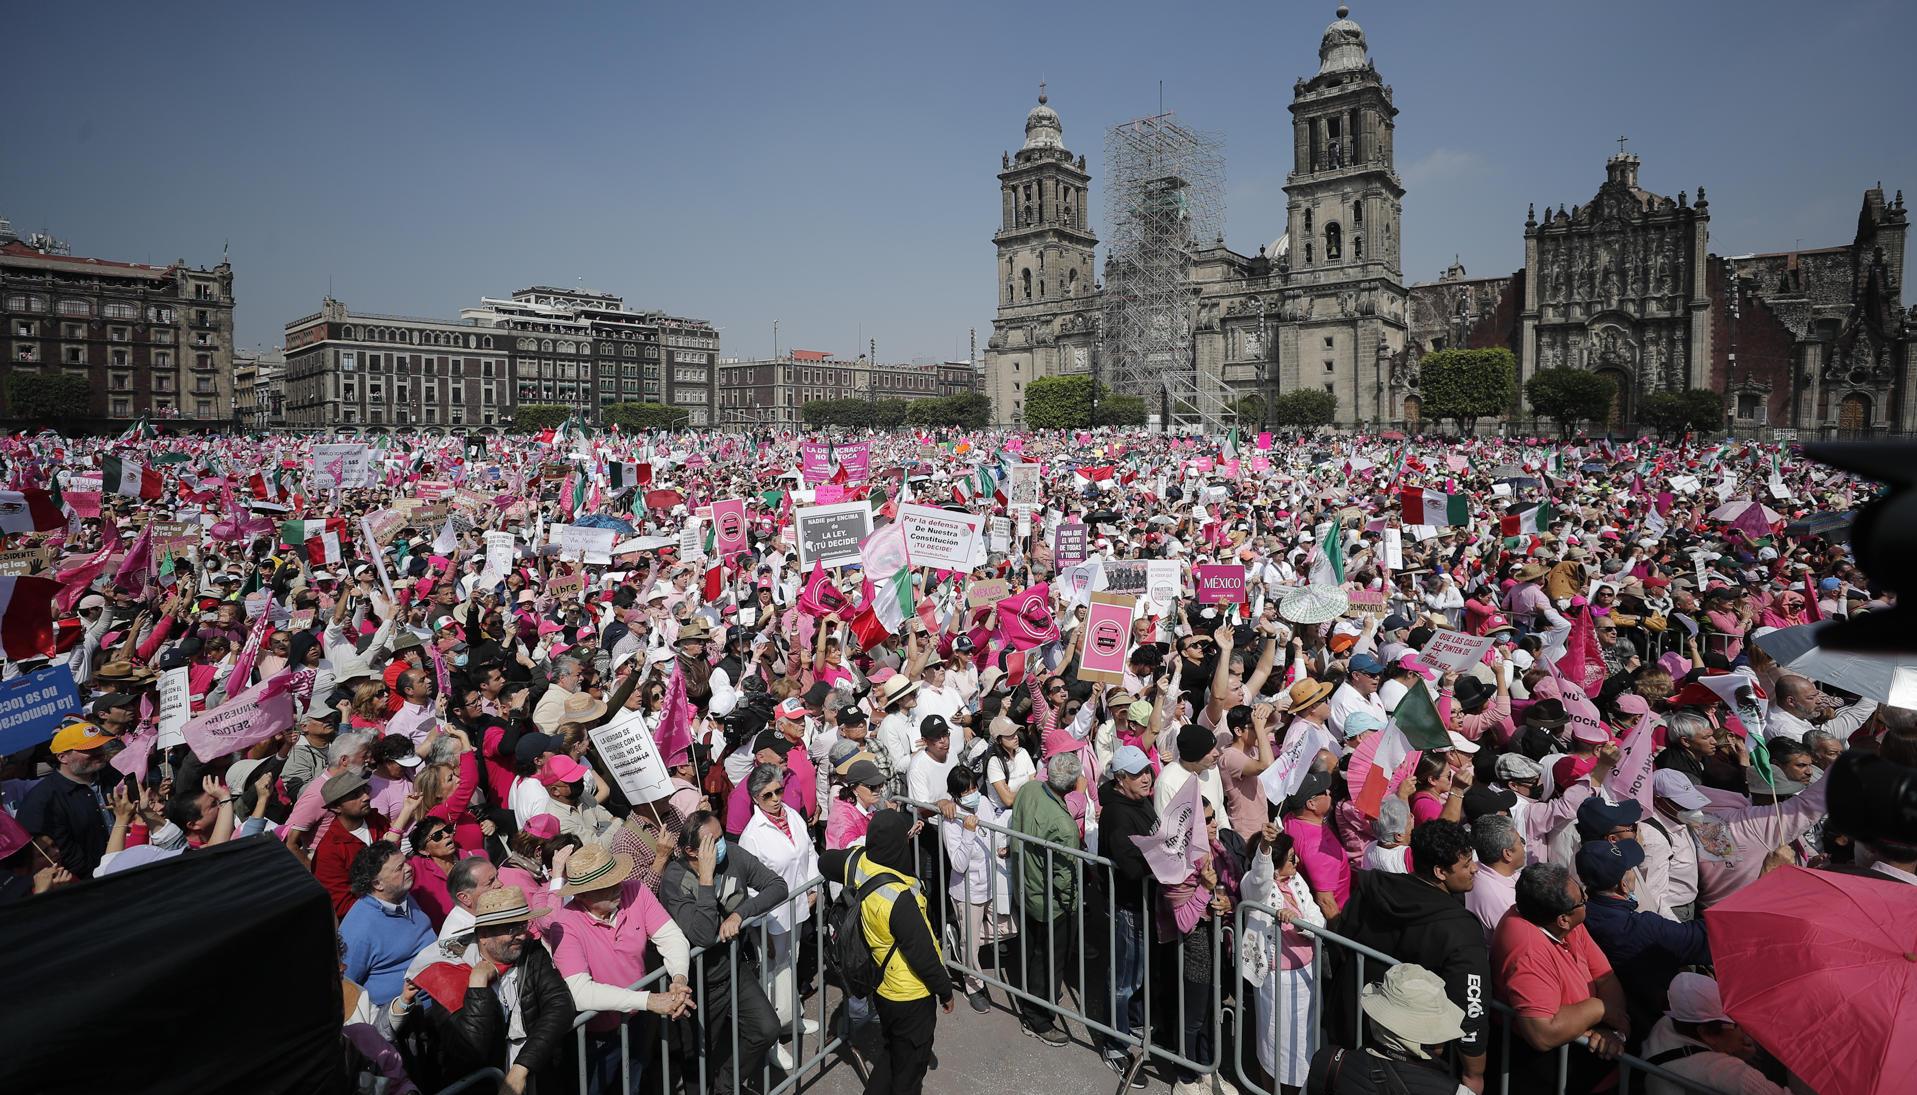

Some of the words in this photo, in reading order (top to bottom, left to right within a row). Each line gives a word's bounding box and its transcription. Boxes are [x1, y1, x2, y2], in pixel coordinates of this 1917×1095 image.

[817, 445, 866, 454] DEOCRACIA
[807, 517, 825, 525] NADIE
[826, 516, 836, 524] por
[836, 513, 859, 521] ENCIMA
[904, 514, 917, 523] Por
[918, 517, 927, 525] la
[928, 519, 959, 530] defensa
[822, 531, 831, 539] LA
[832, 529, 847, 538] LEY.
[915, 525, 926, 533] De
[927, 527, 958, 538] Nuestra
[827, 536, 858, 548] DECIDE!
[1067, 536, 1081, 544] VOTO
[926, 543, 953, 553] DECIDE!
[1066, 543, 1082, 551] TODAS
[1064, 551, 1081, 559] TODOS
[10, 560, 28, 568] las
[1203, 574, 1241, 589] MÉXICO
[549, 582, 578, 597] Libre
[1439, 632, 1452, 642] QUE
[1452, 636, 1463, 644] LAS
[1463, 638, 1483, 648] CALLES
[1433, 640, 1442, 648] SE
[1442, 643, 1463, 654] PINTEN
[1421, 656, 1438, 667] OTRA
[1438, 662, 1452, 671] VEZ
[25, 691, 41, 705] se
[41, 685, 58, 699] no
[0, 701, 57, 731] democra
[606, 731, 622, 743] VERDAD
[622, 728, 630, 736] SE
[623, 736, 636, 747] CON
[635, 733, 643, 741] EL
[627, 747, 635, 755] NO
[635, 743, 643, 752] SE
